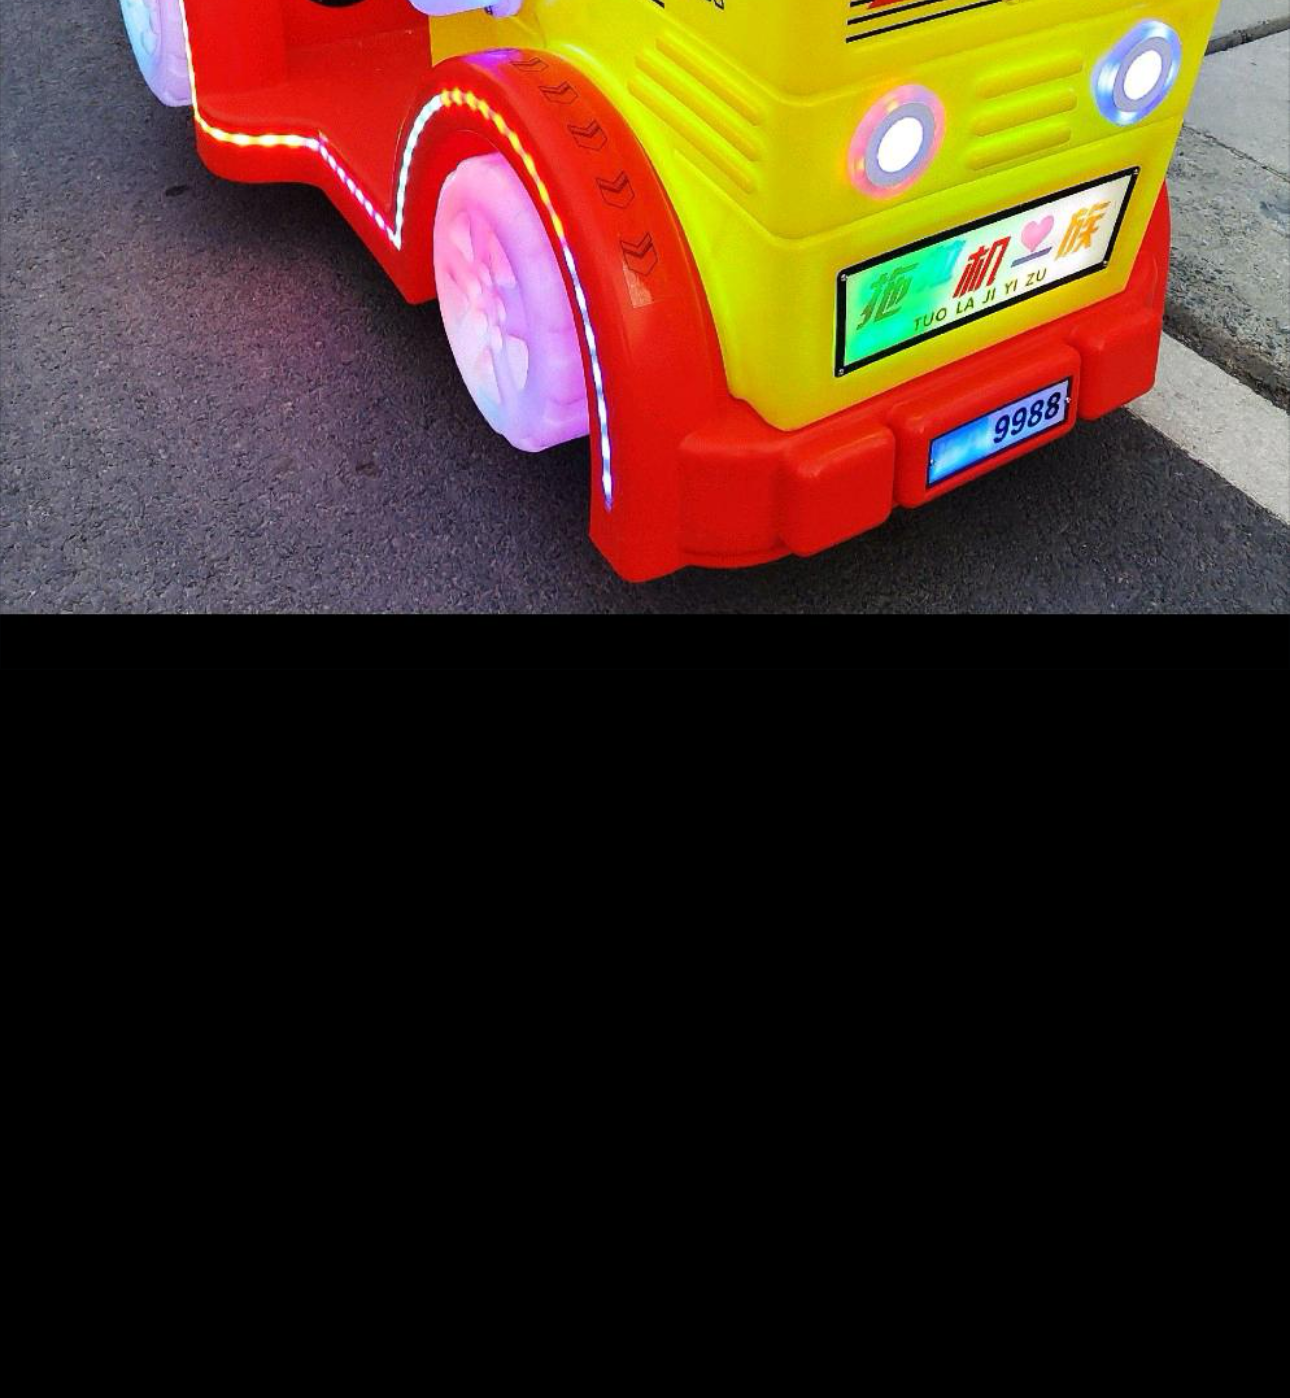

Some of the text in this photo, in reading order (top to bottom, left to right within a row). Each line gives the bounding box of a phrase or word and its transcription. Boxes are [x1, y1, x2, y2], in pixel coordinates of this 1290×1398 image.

[856, 201, 1111, 331] 拖机一族
[912, 267, 1047, 332] TUO LA JI YI ZU
[993, 391, 1061, 444] 9988
